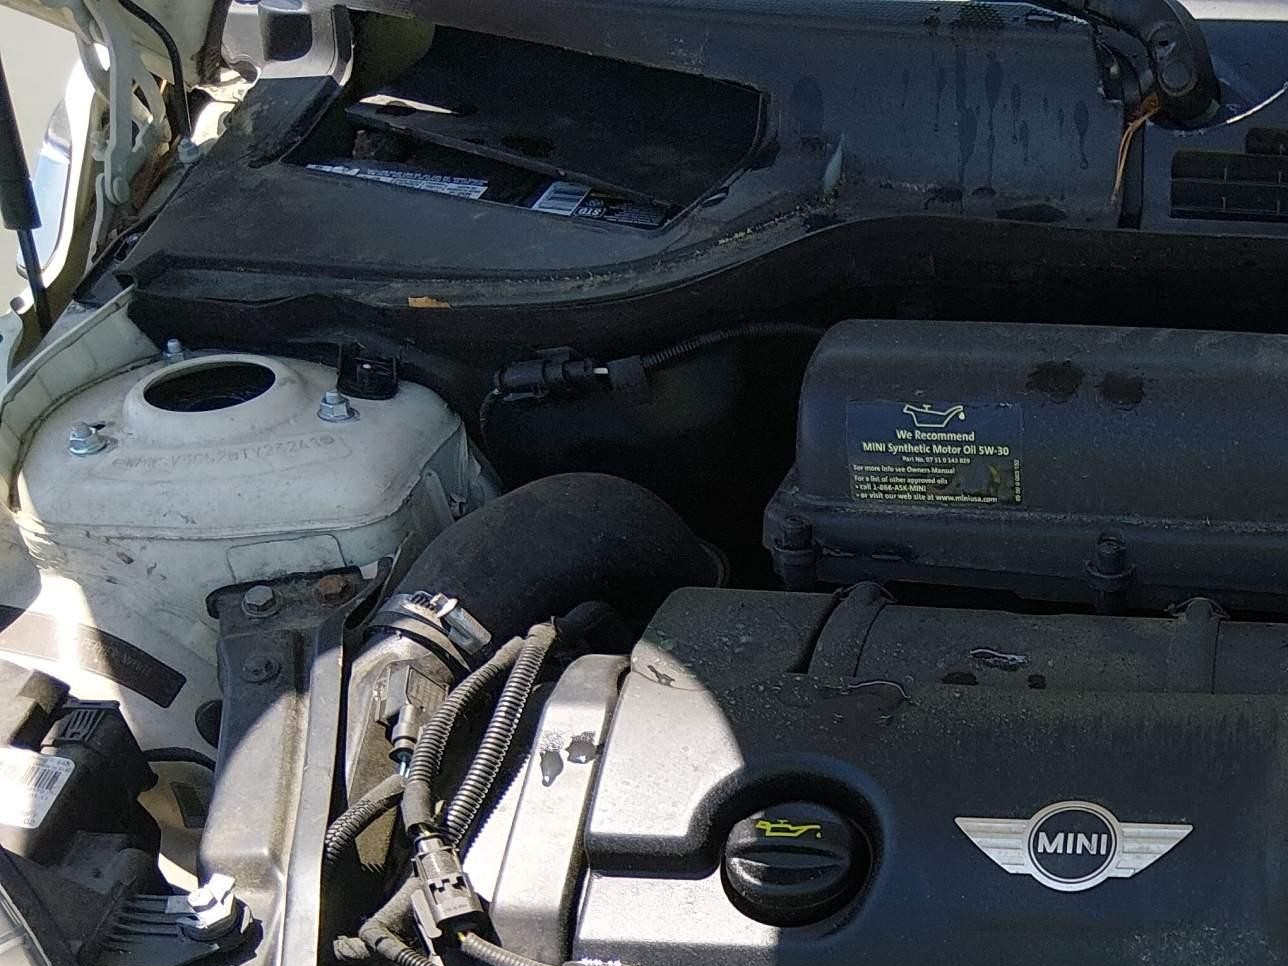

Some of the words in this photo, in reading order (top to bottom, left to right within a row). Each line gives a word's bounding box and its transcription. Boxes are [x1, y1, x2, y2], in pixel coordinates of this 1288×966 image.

[896, 429, 912, 440] We
[914, 430, 975, 441] Recommend
[862, 442, 886, 452] MINI
[887, 443, 930, 455] Synthetic
[932, 445, 962, 454] Motor
[963, 445, 977, 455] Oil
[979, 446, 1009, 456] 5W-30
[907, 477, 935, 485] approved
[935, 494, 998, 503] www.miniusa.com
[1037, 831, 1108, 855] MINI
